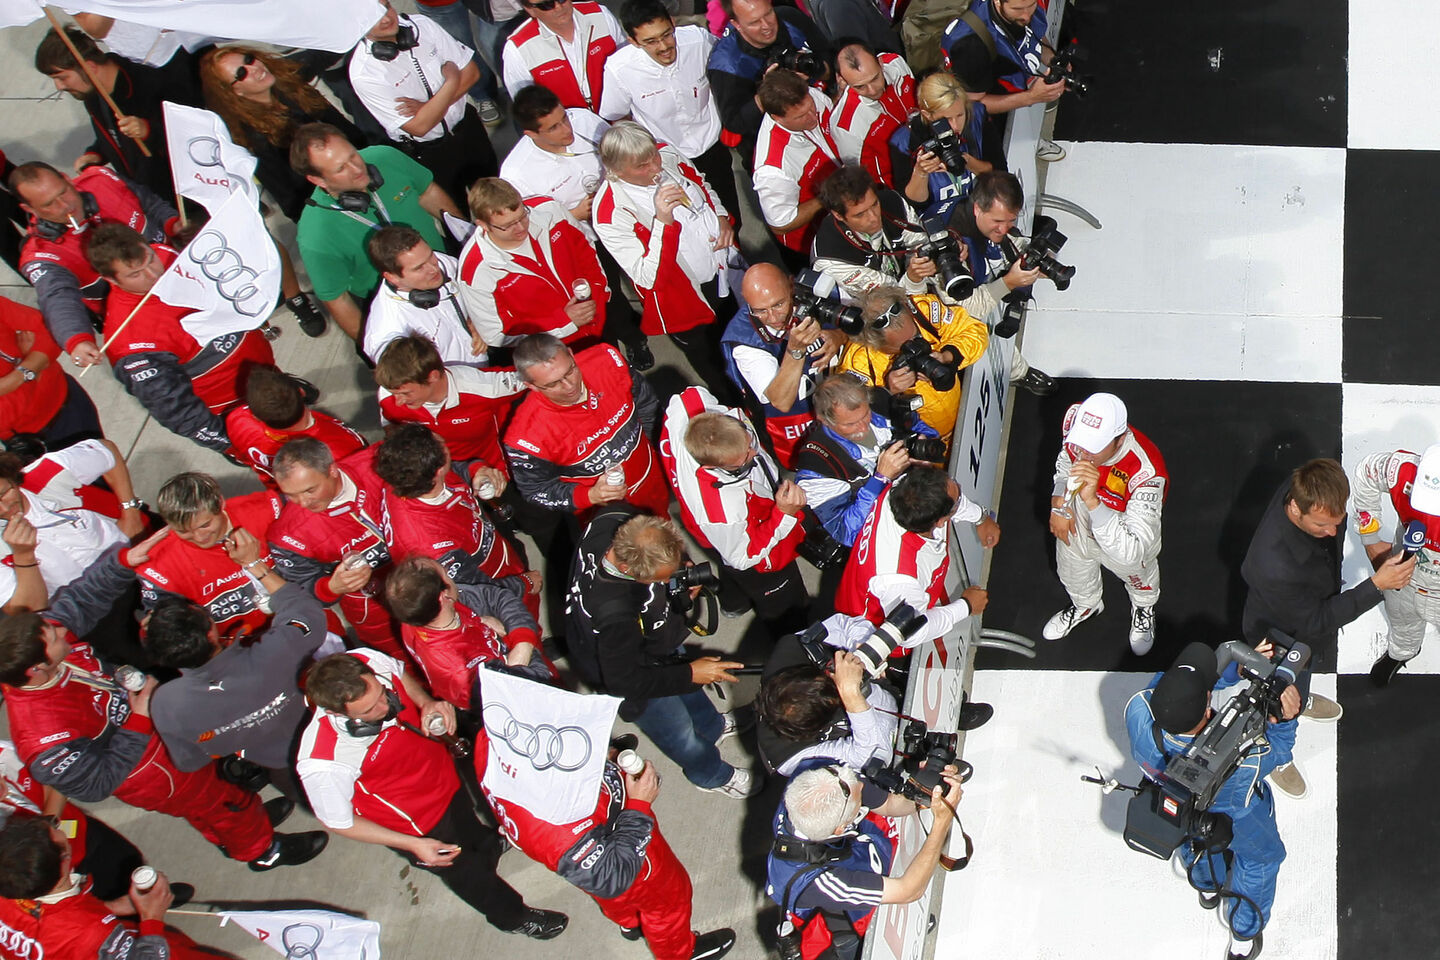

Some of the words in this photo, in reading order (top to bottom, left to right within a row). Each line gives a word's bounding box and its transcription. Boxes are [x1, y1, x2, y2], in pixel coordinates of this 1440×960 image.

[586, 425, 611, 445] Audi
[608, 403, 630, 427] Sport
[583, 444, 612, 469] Audi
[806, 443, 830, 458] Canon
[210, 591, 242, 613] Audi
